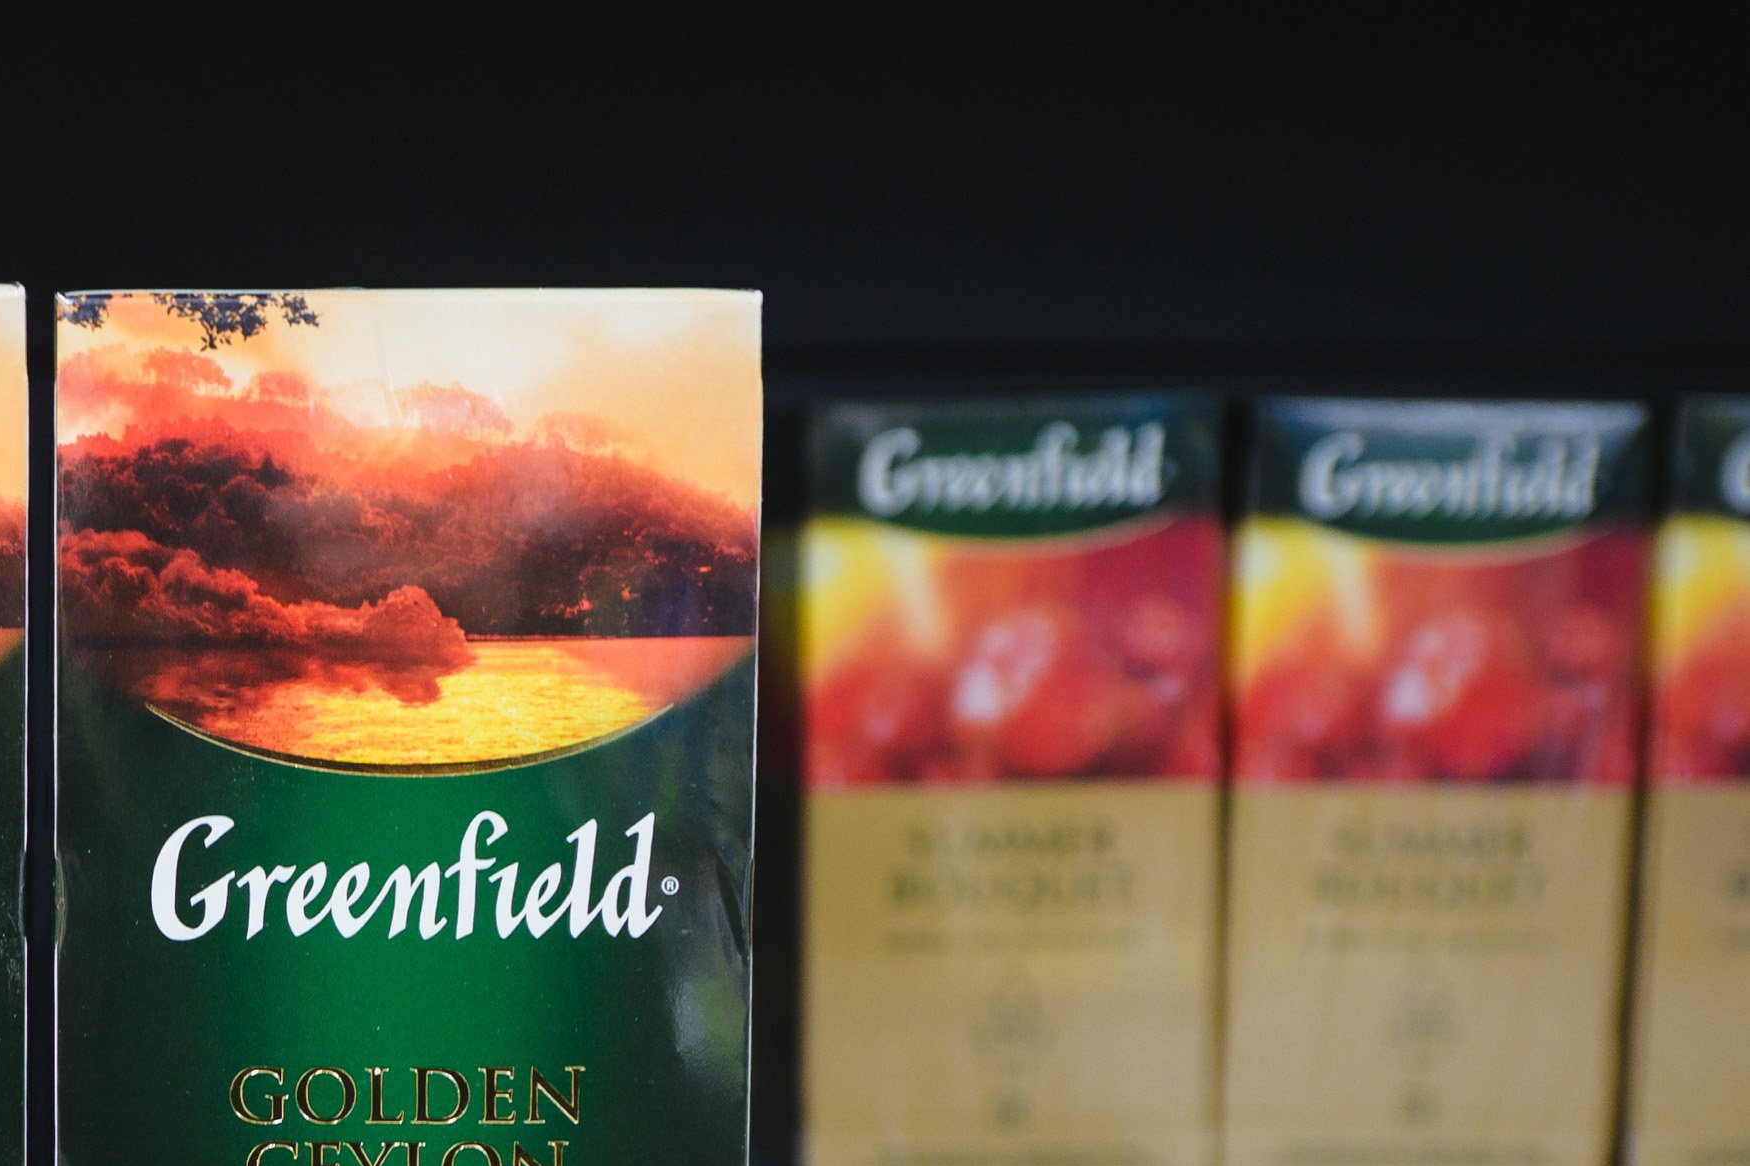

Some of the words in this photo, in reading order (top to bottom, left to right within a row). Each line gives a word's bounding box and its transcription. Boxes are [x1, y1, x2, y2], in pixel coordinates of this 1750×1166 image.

[858, 421, 1166, 516] Greenfield
[1298, 429, 1602, 520] Greenfield
[151, 810, 663, 941] Greenfield
[229, 1065, 586, 1125] GOLDEN
